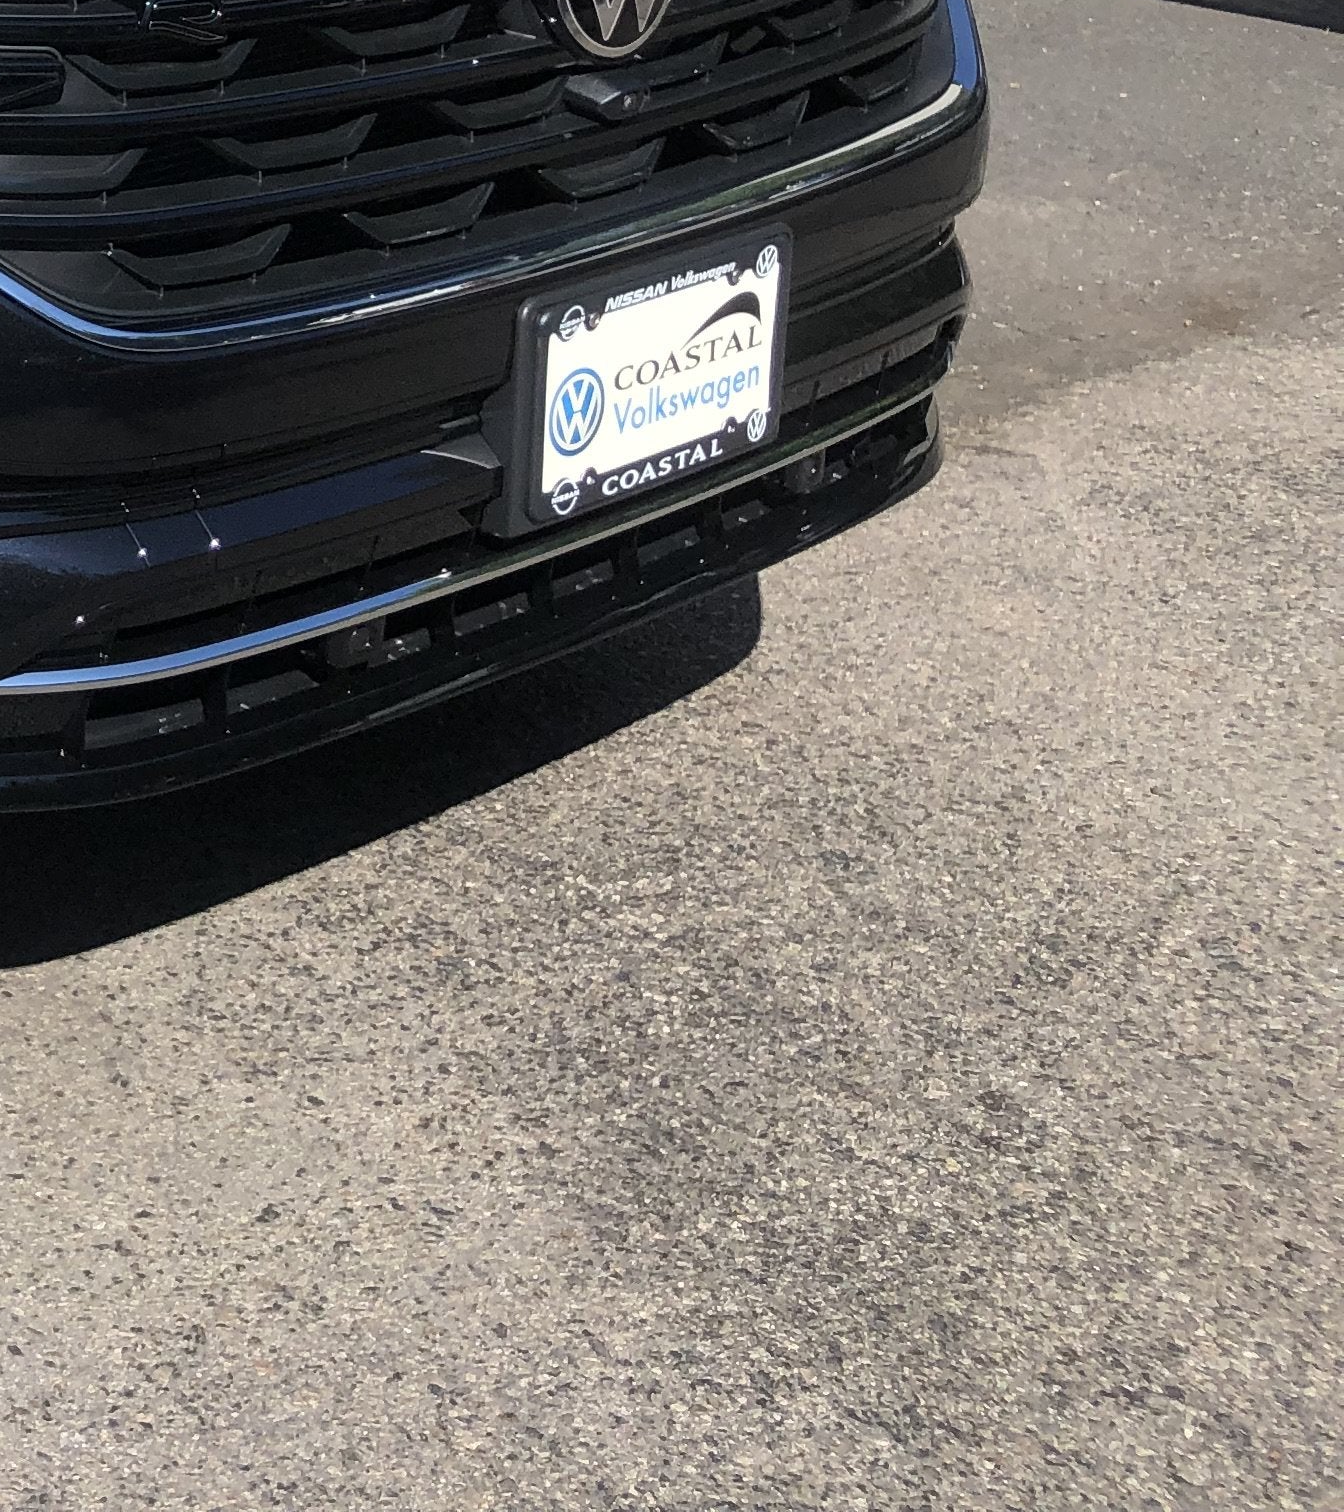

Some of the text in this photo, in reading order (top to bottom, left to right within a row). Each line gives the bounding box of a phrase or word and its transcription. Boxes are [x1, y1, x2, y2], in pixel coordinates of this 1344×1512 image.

[605, 262, 736, 312] NISSAN Volkswagen
[614, 326, 762, 391] COASTAL
[613, 364, 760, 434] Volkswagen
[601, 438, 723, 496] COASTAL
